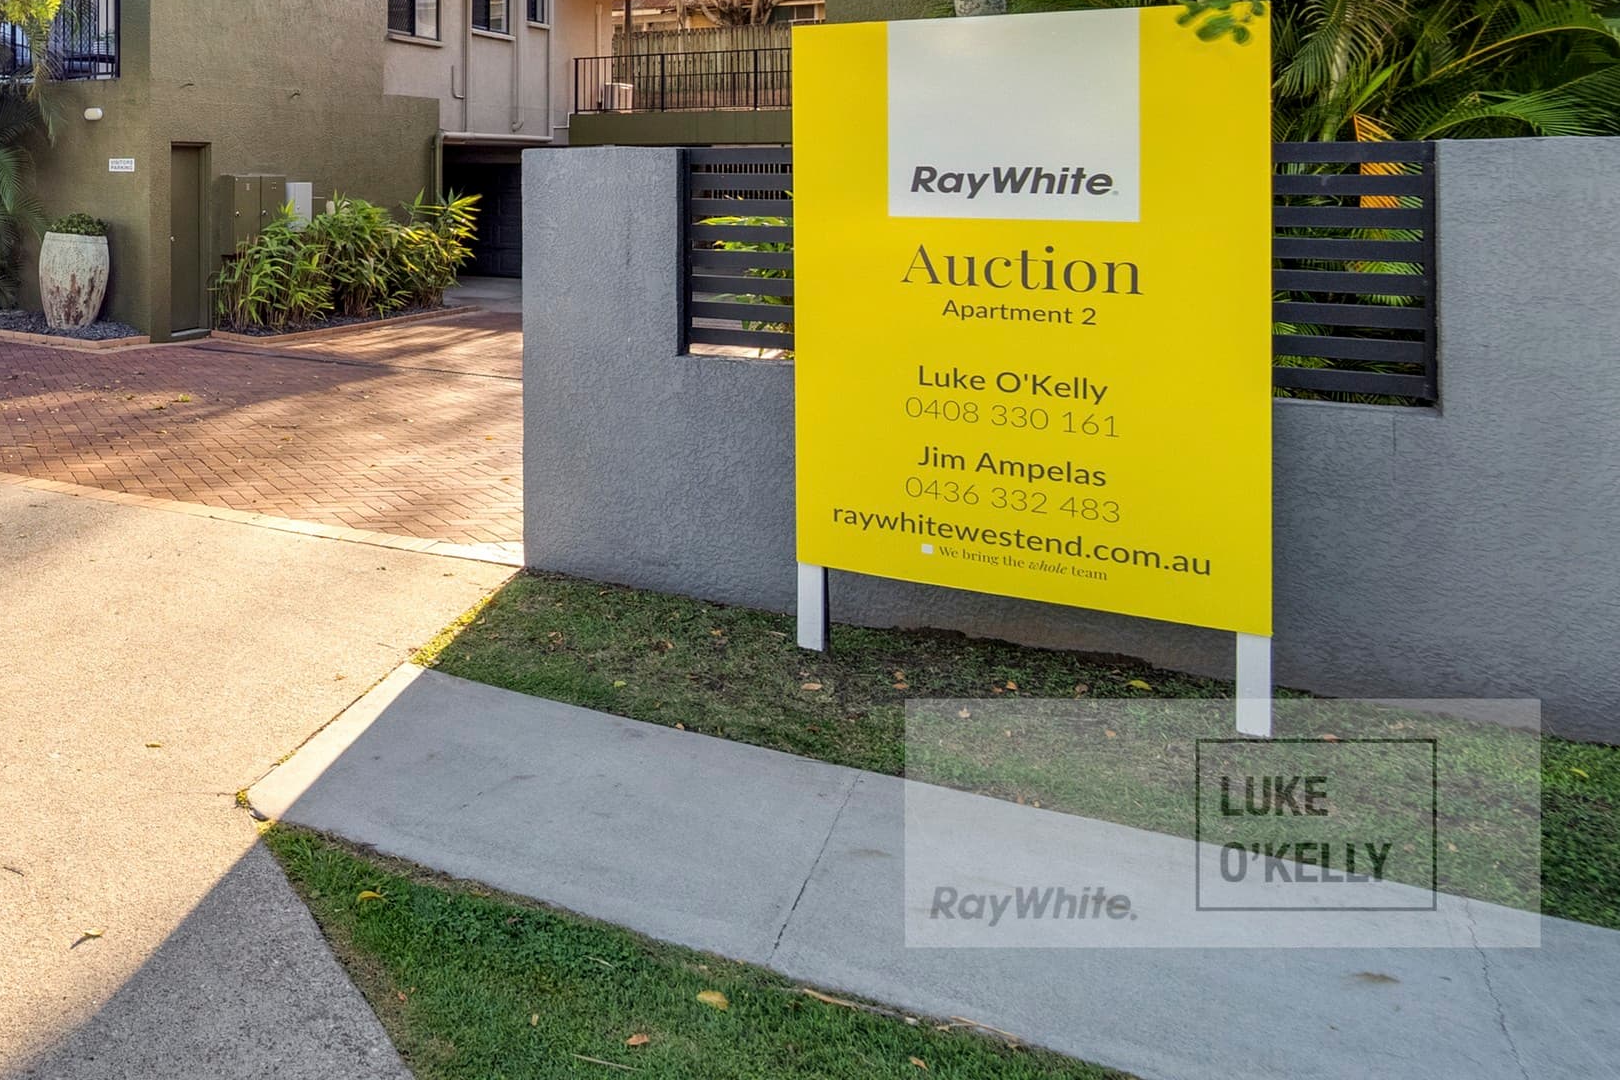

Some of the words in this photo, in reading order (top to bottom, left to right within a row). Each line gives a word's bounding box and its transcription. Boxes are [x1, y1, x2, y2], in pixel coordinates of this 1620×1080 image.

[900, 243, 1144, 296] Auction
[941, 299, 1073, 325] Apartment
[1081, 308, 1097, 326] 2
[917, 365, 986, 392] Luke
[995, 371, 1108, 405] O'Kelly
[905, 396, 980, 424] 0408
[990, 405, 1049, 431] 330
[1062, 411, 1120, 438] 161
[917, 445, 965, 471] Jim
[975, 452, 1107, 487] Ampelas
[905, 476, 980, 506] 0436
[990, 487, 1048, 515] 332
[1059, 496, 1121, 524] 483
[832, 506, 1211, 576] raywhitewestend.com.au
[939, 546, 959, 559] We
[962, 550, 999, 566] bring
[1003, 555, 1025, 569] the
[1028, 560, 1068, 575] whole
[1071, 567, 1108, 581] team
